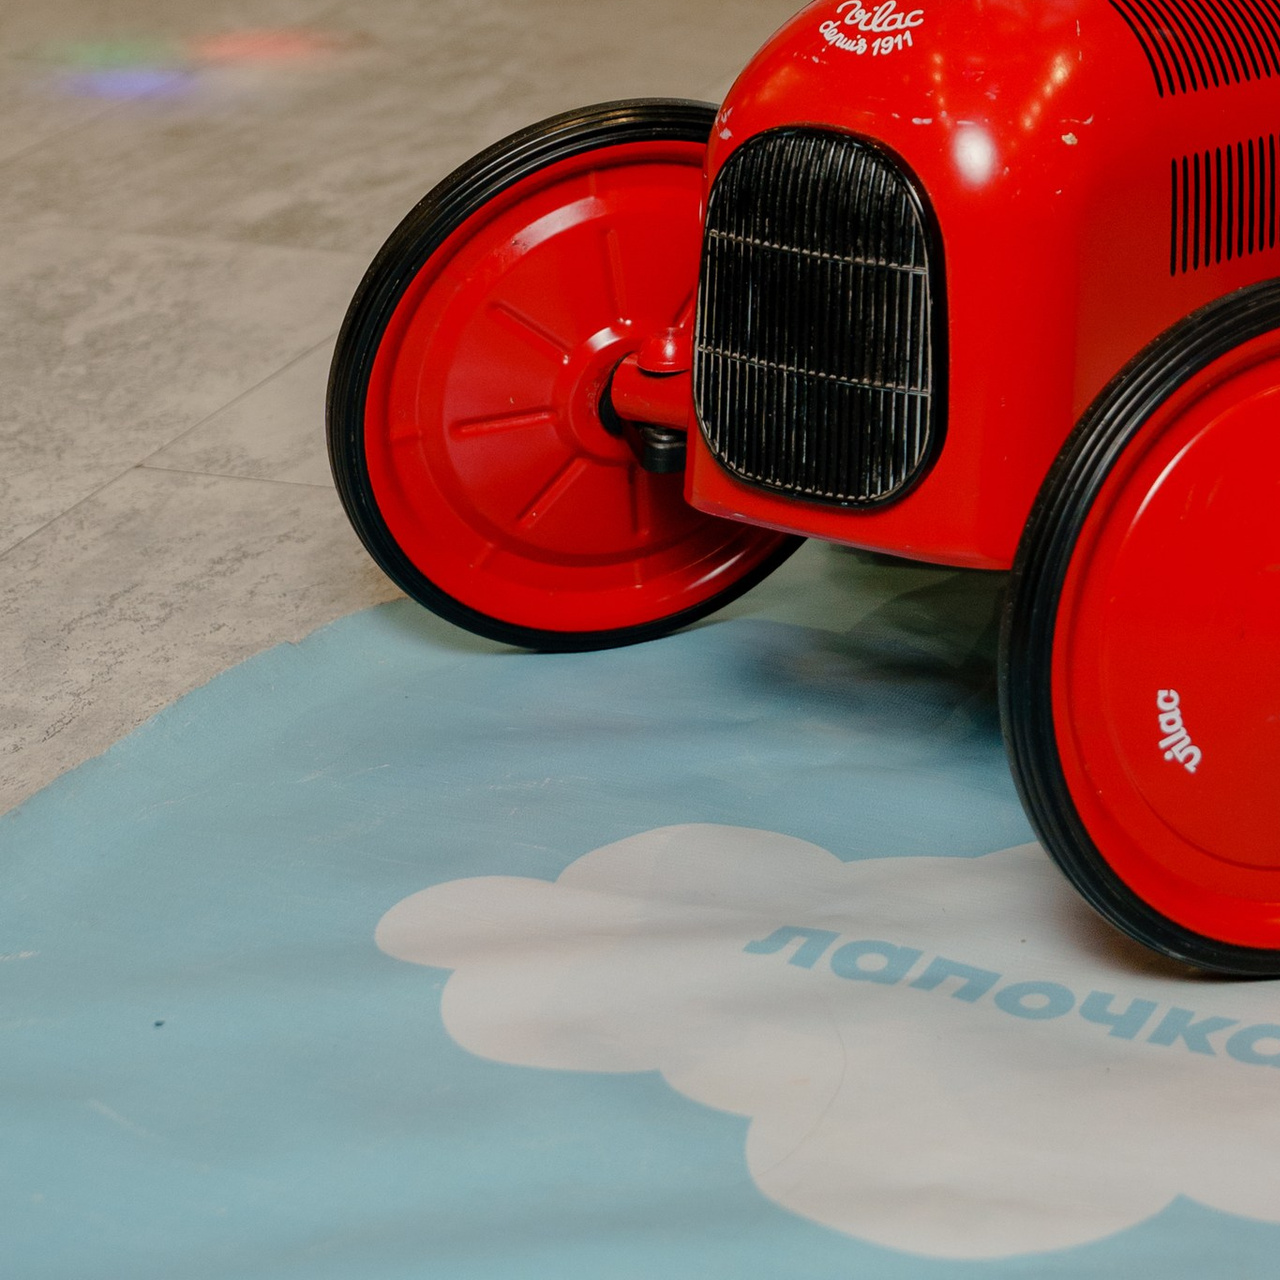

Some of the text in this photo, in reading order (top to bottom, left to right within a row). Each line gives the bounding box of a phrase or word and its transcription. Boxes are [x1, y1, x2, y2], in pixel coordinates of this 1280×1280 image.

[836, 0, 924, 32] Vilac
[819, 20, 913, 56] depuis 1911
[1156, 688, 1203, 774] vilac
